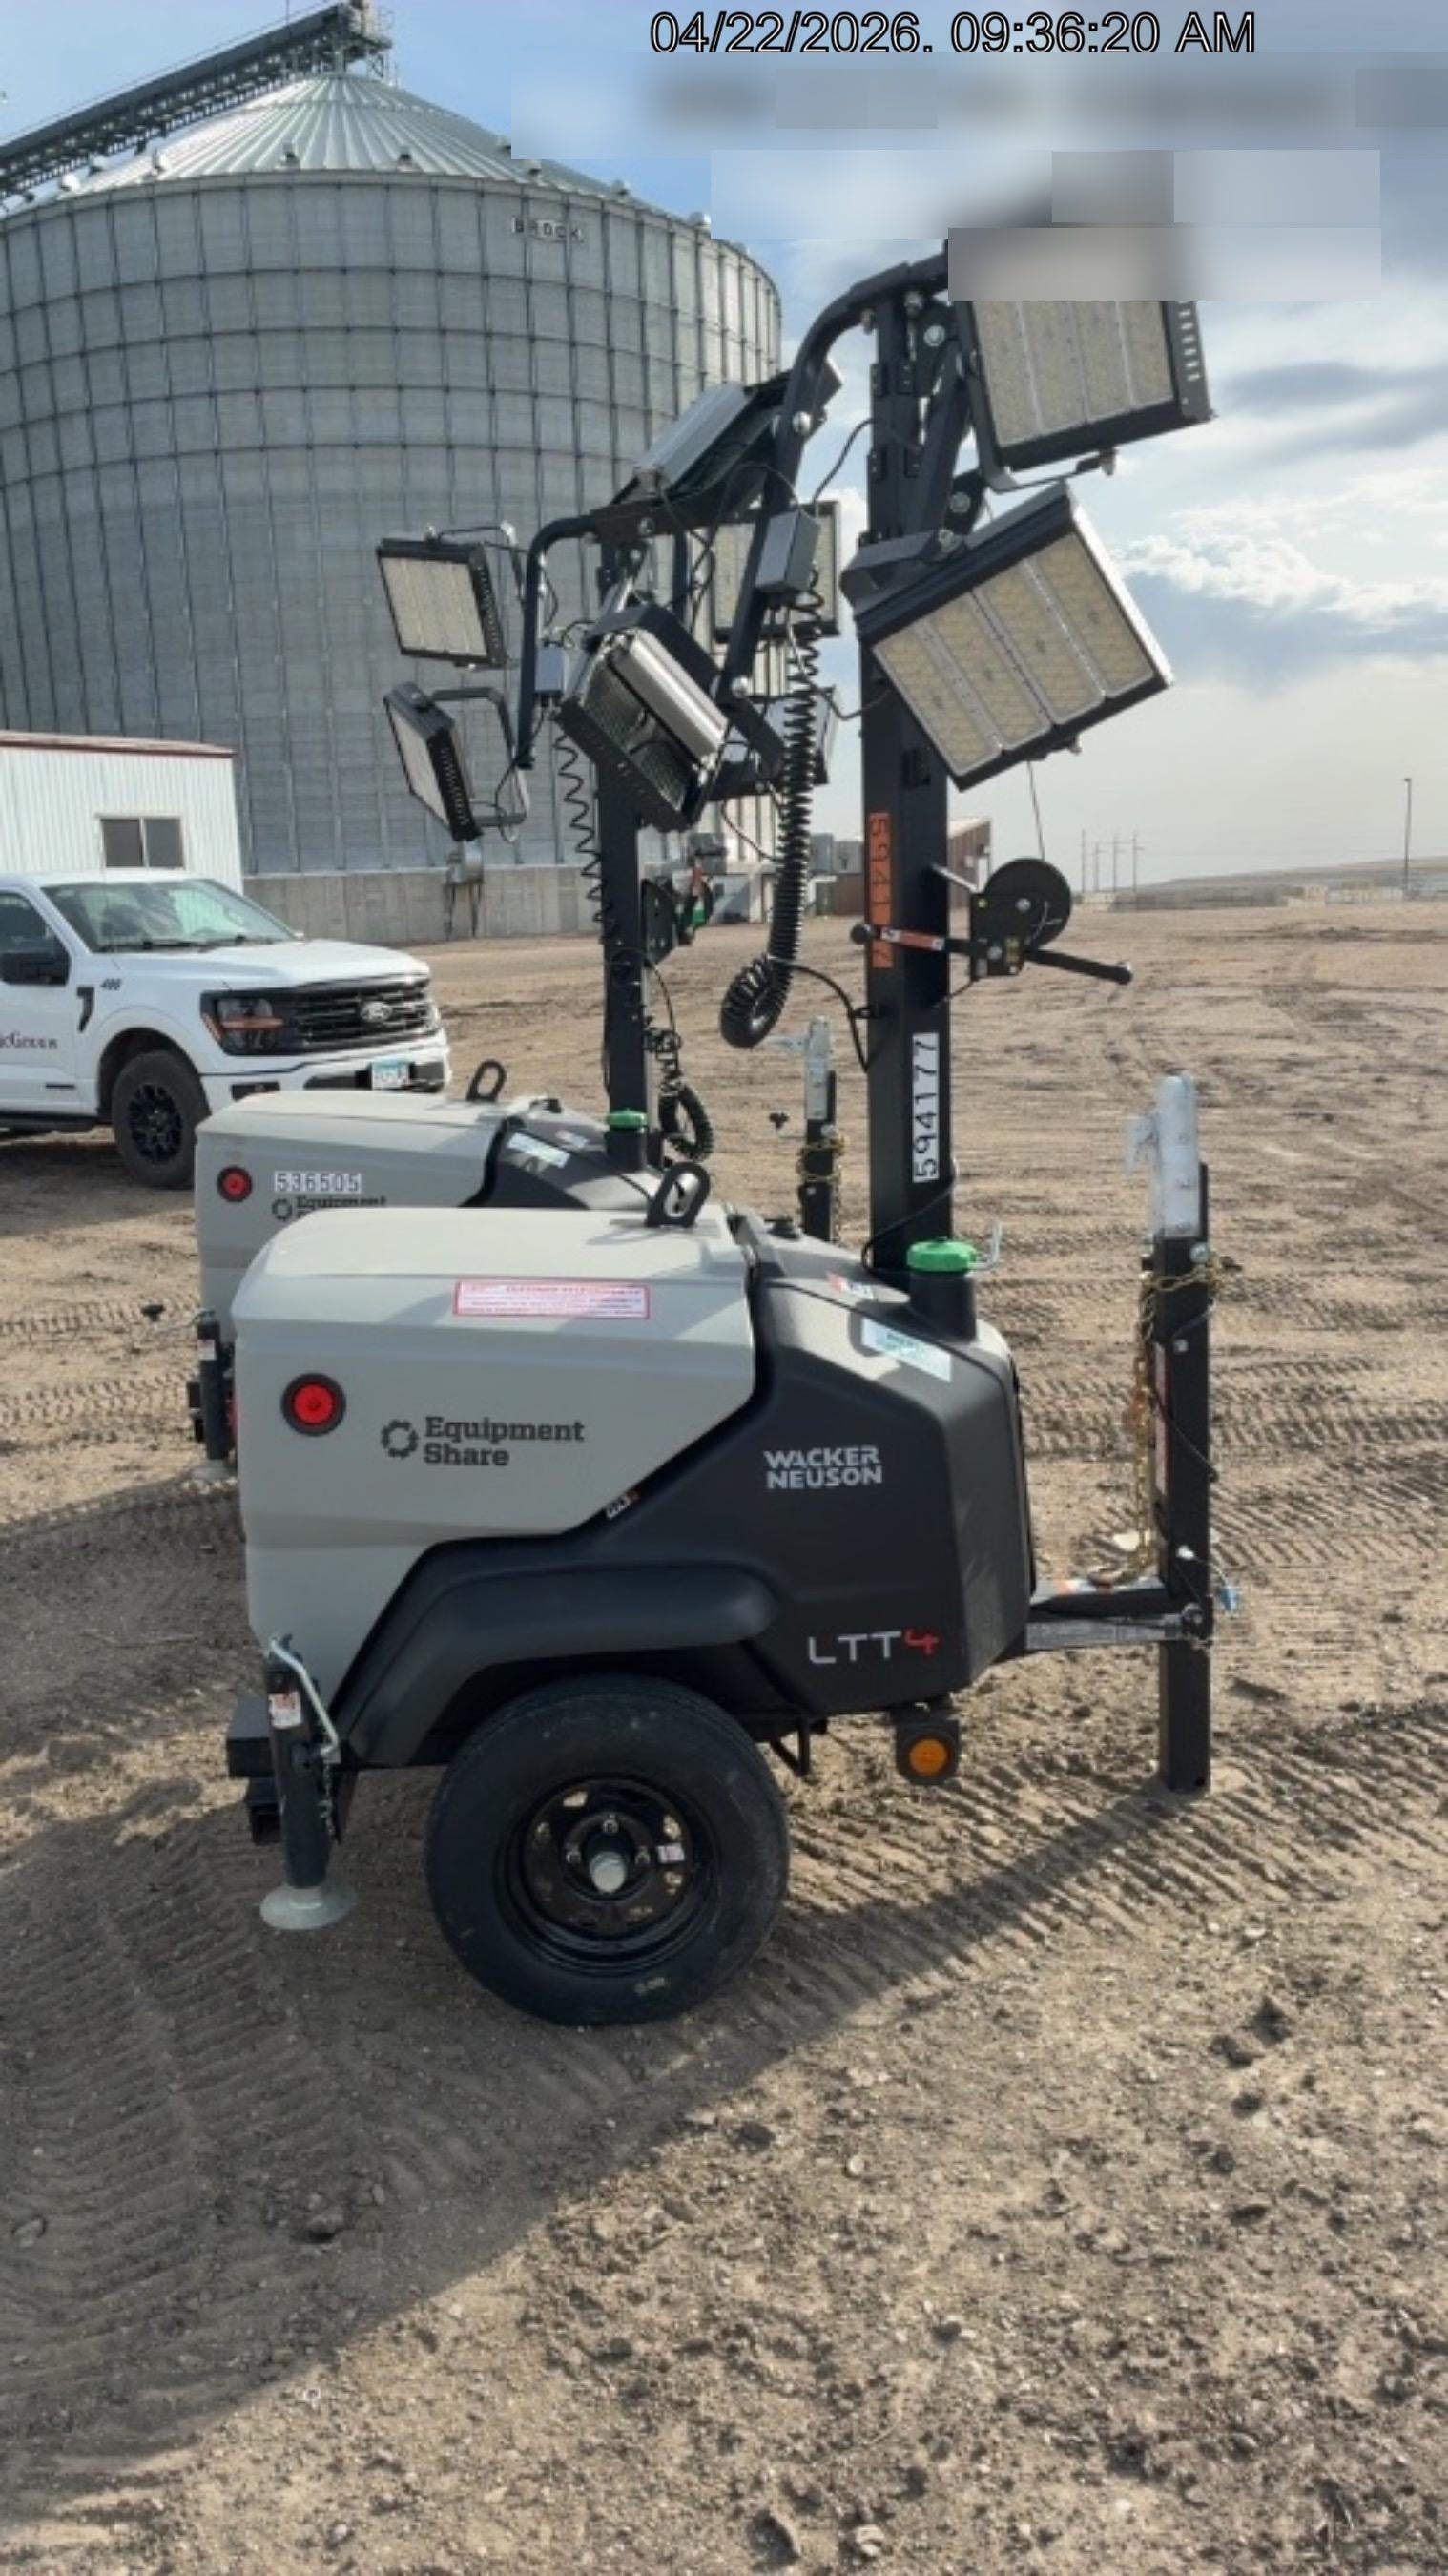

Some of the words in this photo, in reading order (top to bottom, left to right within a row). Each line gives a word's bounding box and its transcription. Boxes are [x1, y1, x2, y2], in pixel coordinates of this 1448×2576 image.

[914, 1039, 938, 1177] 594177
[277, 1173, 359, 1193] 536505
[425, 1416, 585, 1444] Equipment
[424, 1442, 509, 1466] Share
[764, 1445, 879, 1469] WACKER
[767, 1465, 882, 1489] NEUSON
